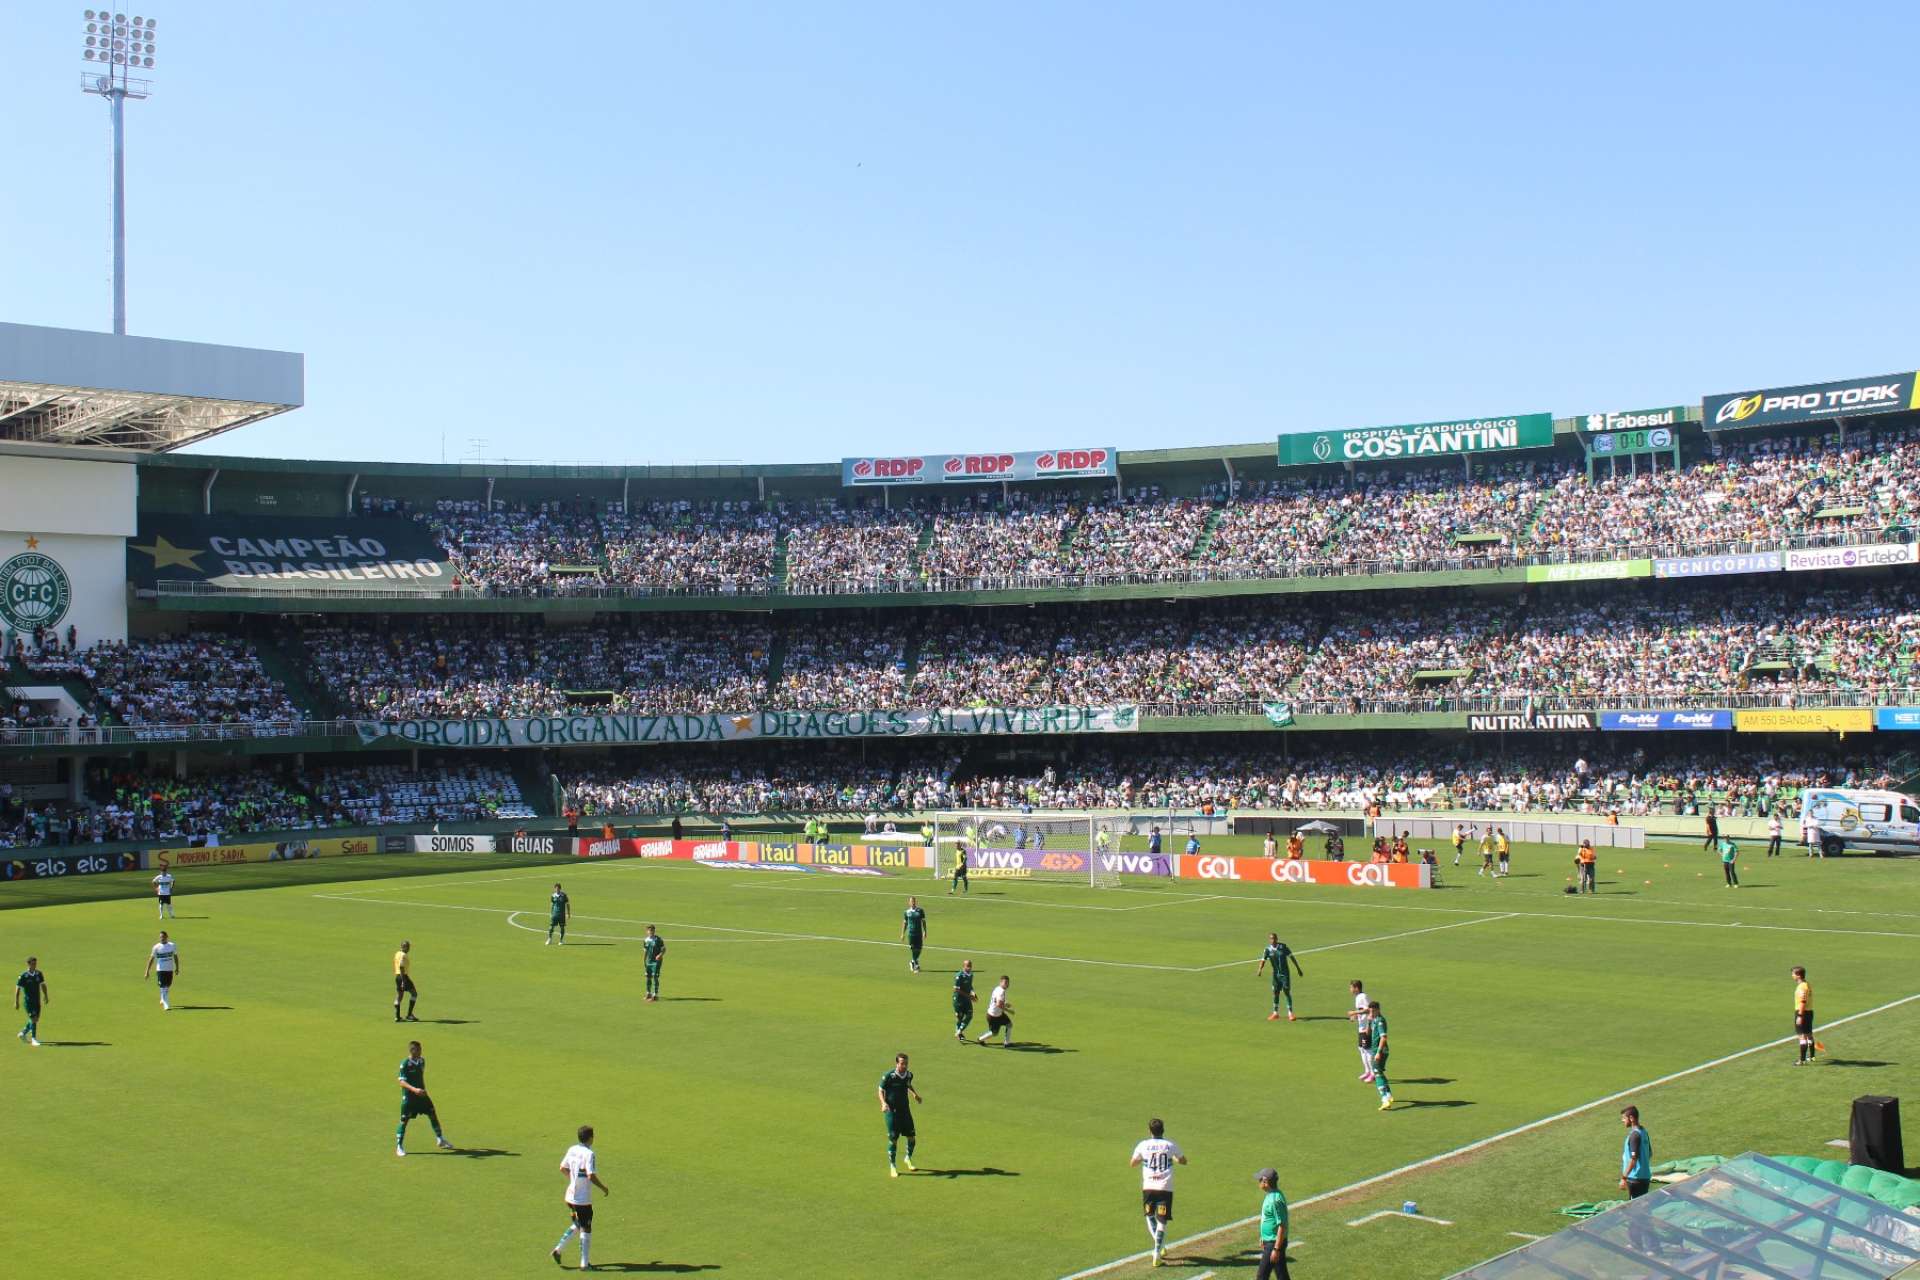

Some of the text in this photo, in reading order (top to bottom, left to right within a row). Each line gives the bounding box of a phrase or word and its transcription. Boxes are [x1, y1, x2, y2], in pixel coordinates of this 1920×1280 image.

[1763, 383, 1901, 412] PRO TORK
[1343, 419, 1517, 440] HOSPITAL CARDIOLÓGICO
[1606, 410, 1673, 430] Fabesul
[1343, 427, 1517, 459] COSTANTINI
[875, 458, 924, 476] RDP
[965, 455, 1015, 473] RDP
[1057, 450, 1106, 469] RDP
[209, 535, 387, 558] CAMPEÃO
[223, 558, 443, 580] BRASILEIRO
[1790, 554, 1841, 567] Revista
[1548, 563, 1629, 579] NETSHOES
[12, 584, 53, 602] CFC
[380, 719, 513, 745] TORCIDA
[526, 715, 724, 743] ORGANIZADA
[1743, 716, 1758, 726] AM
[1760, 715, 1777, 726] 550
[1779, 715, 1813, 725] BANDA
[341, 840, 369, 854] Sadia
[431, 836, 474, 851] SOMOS
[511, 837, 554, 854] IGUAIS
[589, 838, 621, 857] BRAHMA
[640, 840, 673, 858] BRAHMA
[692, 841, 728, 860] BRAHMA
[761, 843, 795, 862] Itaú
[815, 844, 849, 864] Itaú
[869, 847, 905, 866] Itaú
[1197, 857, 1240, 880] GOL
[1270, 859, 1316, 883] GOL
[1347, 863, 1396, 886] GOL
[1149, 1152, 1168, 1172] 40
